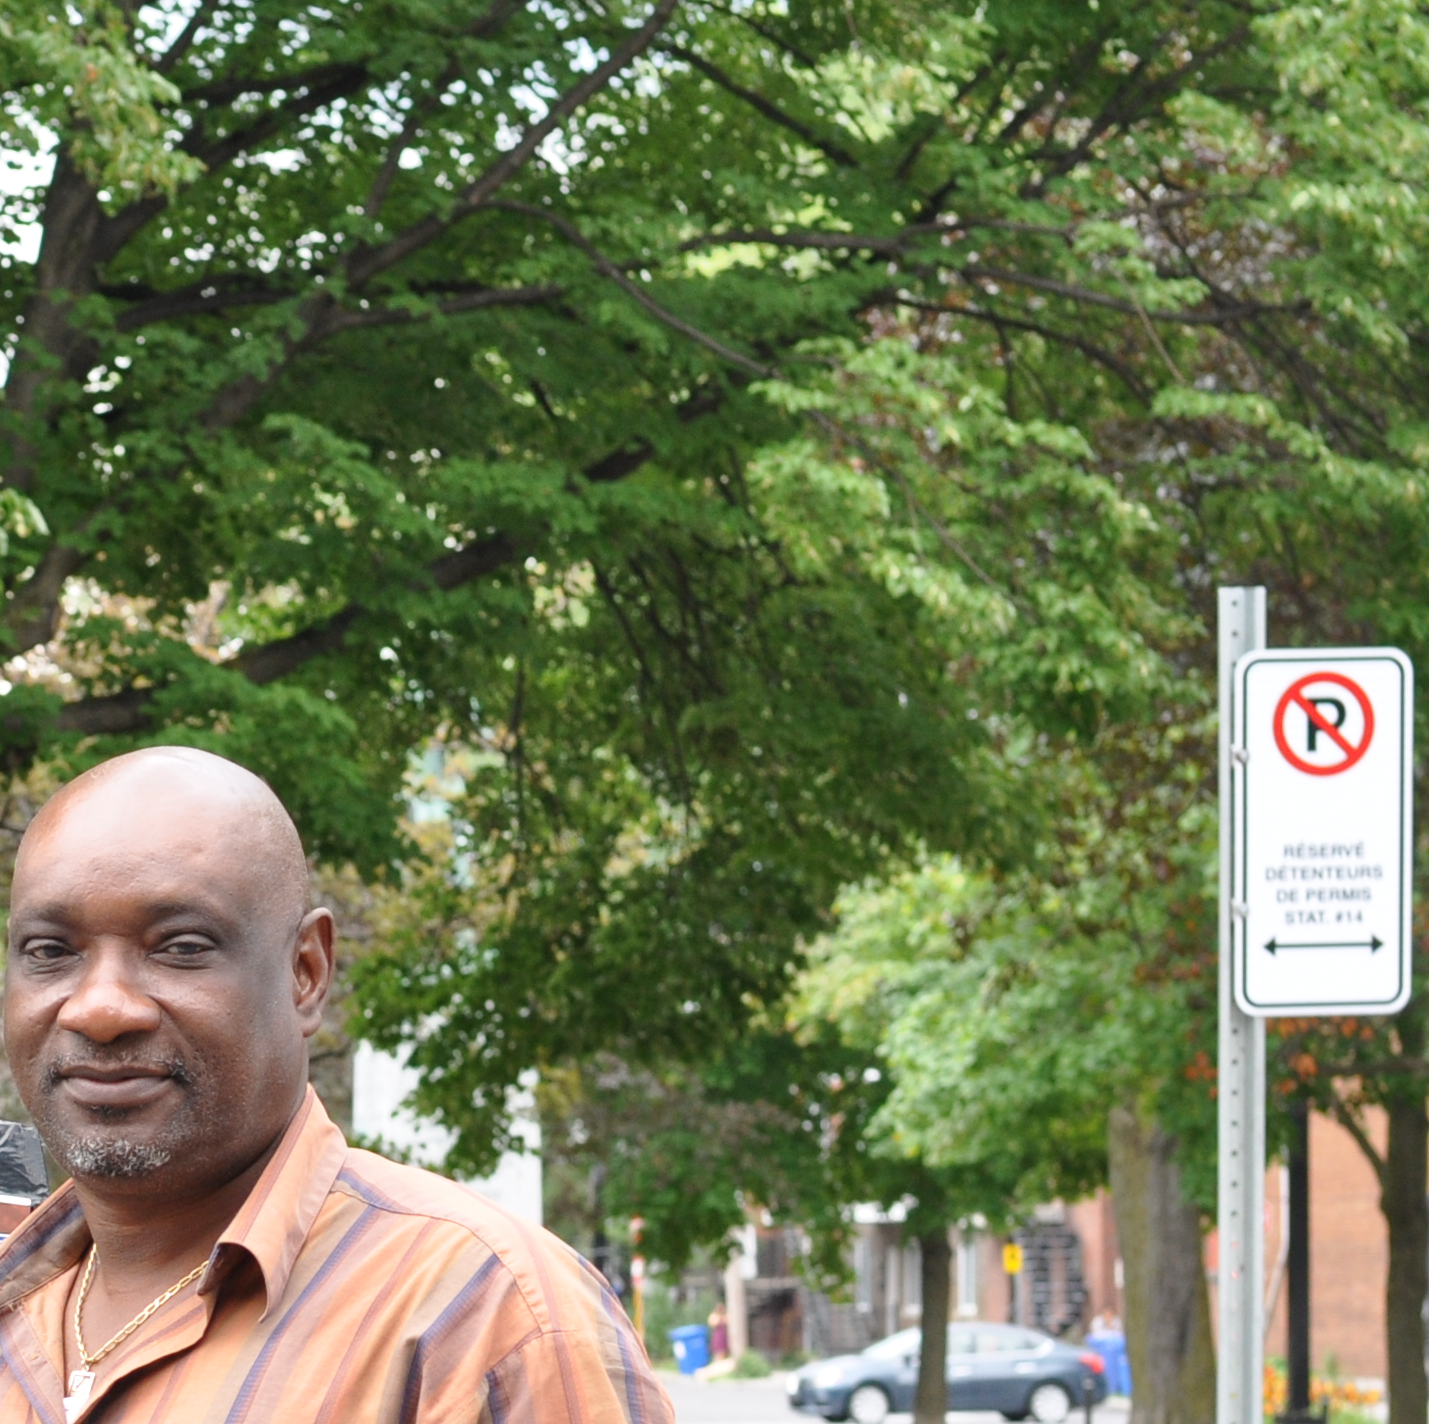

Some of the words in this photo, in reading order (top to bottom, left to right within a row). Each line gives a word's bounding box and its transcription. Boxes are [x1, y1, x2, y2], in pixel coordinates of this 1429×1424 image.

[1283, 841, 1365, 859] RÉSERVÉ
[1265, 864, 1383, 881] DÉTENTEURS
[1276, 888, 1298, 903] DE
[1305, 887, 1372, 903] PERMIS
